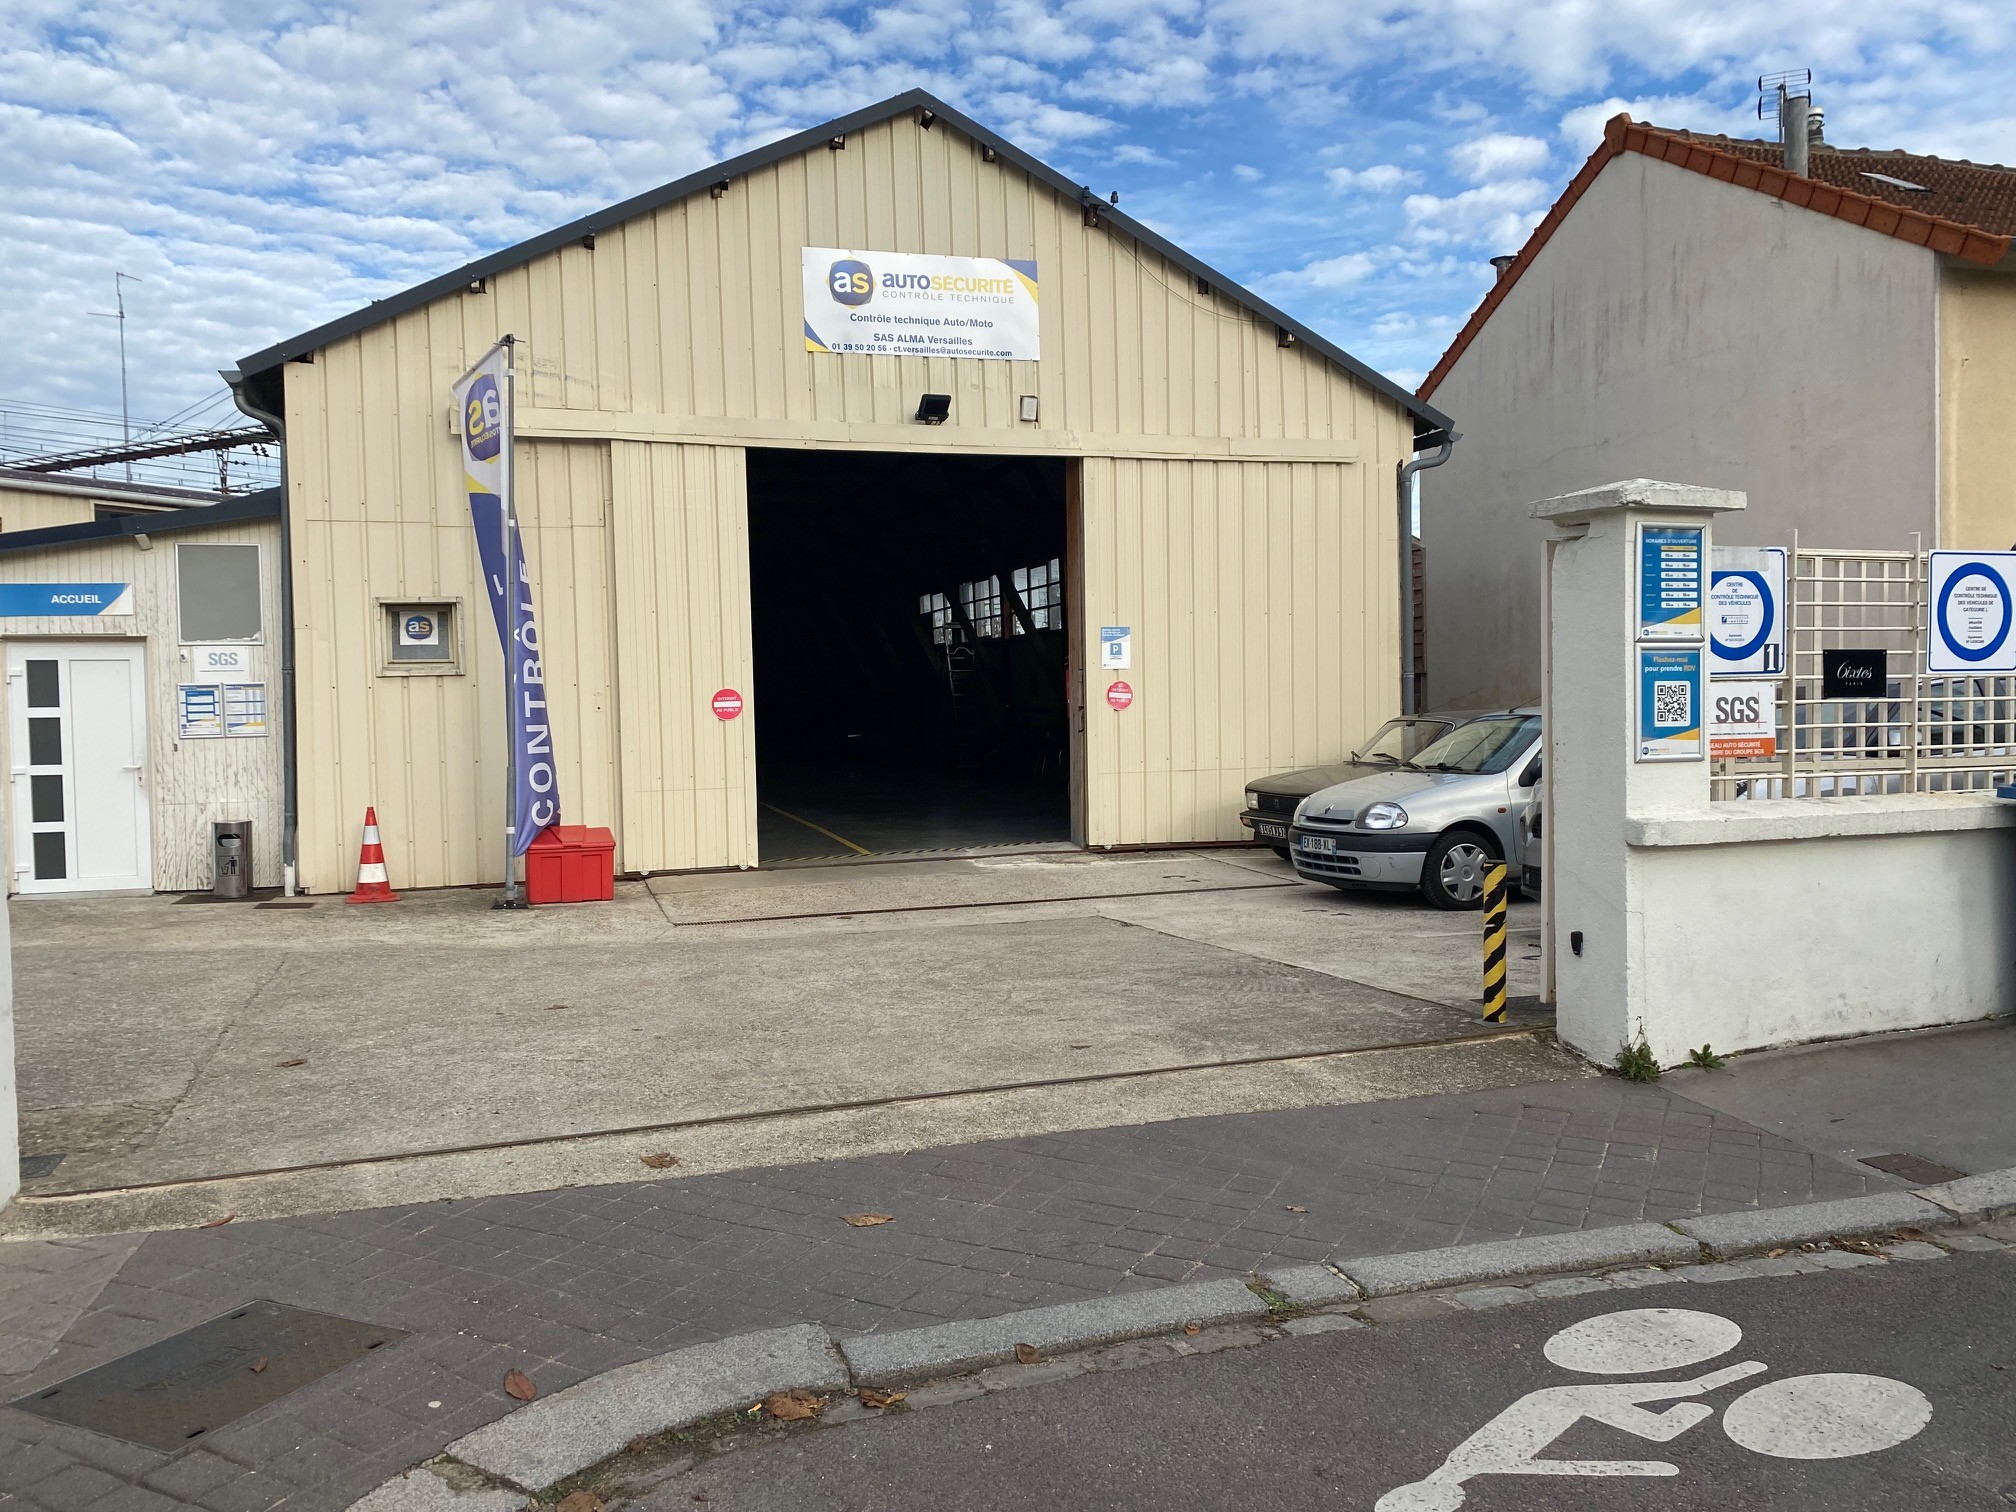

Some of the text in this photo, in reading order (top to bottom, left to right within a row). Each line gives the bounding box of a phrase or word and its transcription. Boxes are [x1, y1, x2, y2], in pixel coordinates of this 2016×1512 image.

[833, 271, 870, 294] as
[882, 290, 1015, 305] CONTRÔLE TECHNIQUE
[849, 313, 994, 328] Contrôle technique Auto/Moto
[873, 332, 973, 346] SAS ALMA Versailles
[831, 342, 841, 350] 01
[843, 343, 853, 351] 39
[854, 344, 865, 352] 50
[866, 344, 876, 352] 20
[893, 345, 1013, 357] ct.versailles@autosecurite.com
[51, 594, 102, 604] ACCUEIL
[408, 621, 430, 632] as
[208, 652, 238, 666] SGS
[1766, 644, 1776, 671] 1
[1660, 665, 1683, 673] prendre
[1715, 696, 1760, 724] SGS
[1737, 740, 1761, 748] SÉCURITÉ
